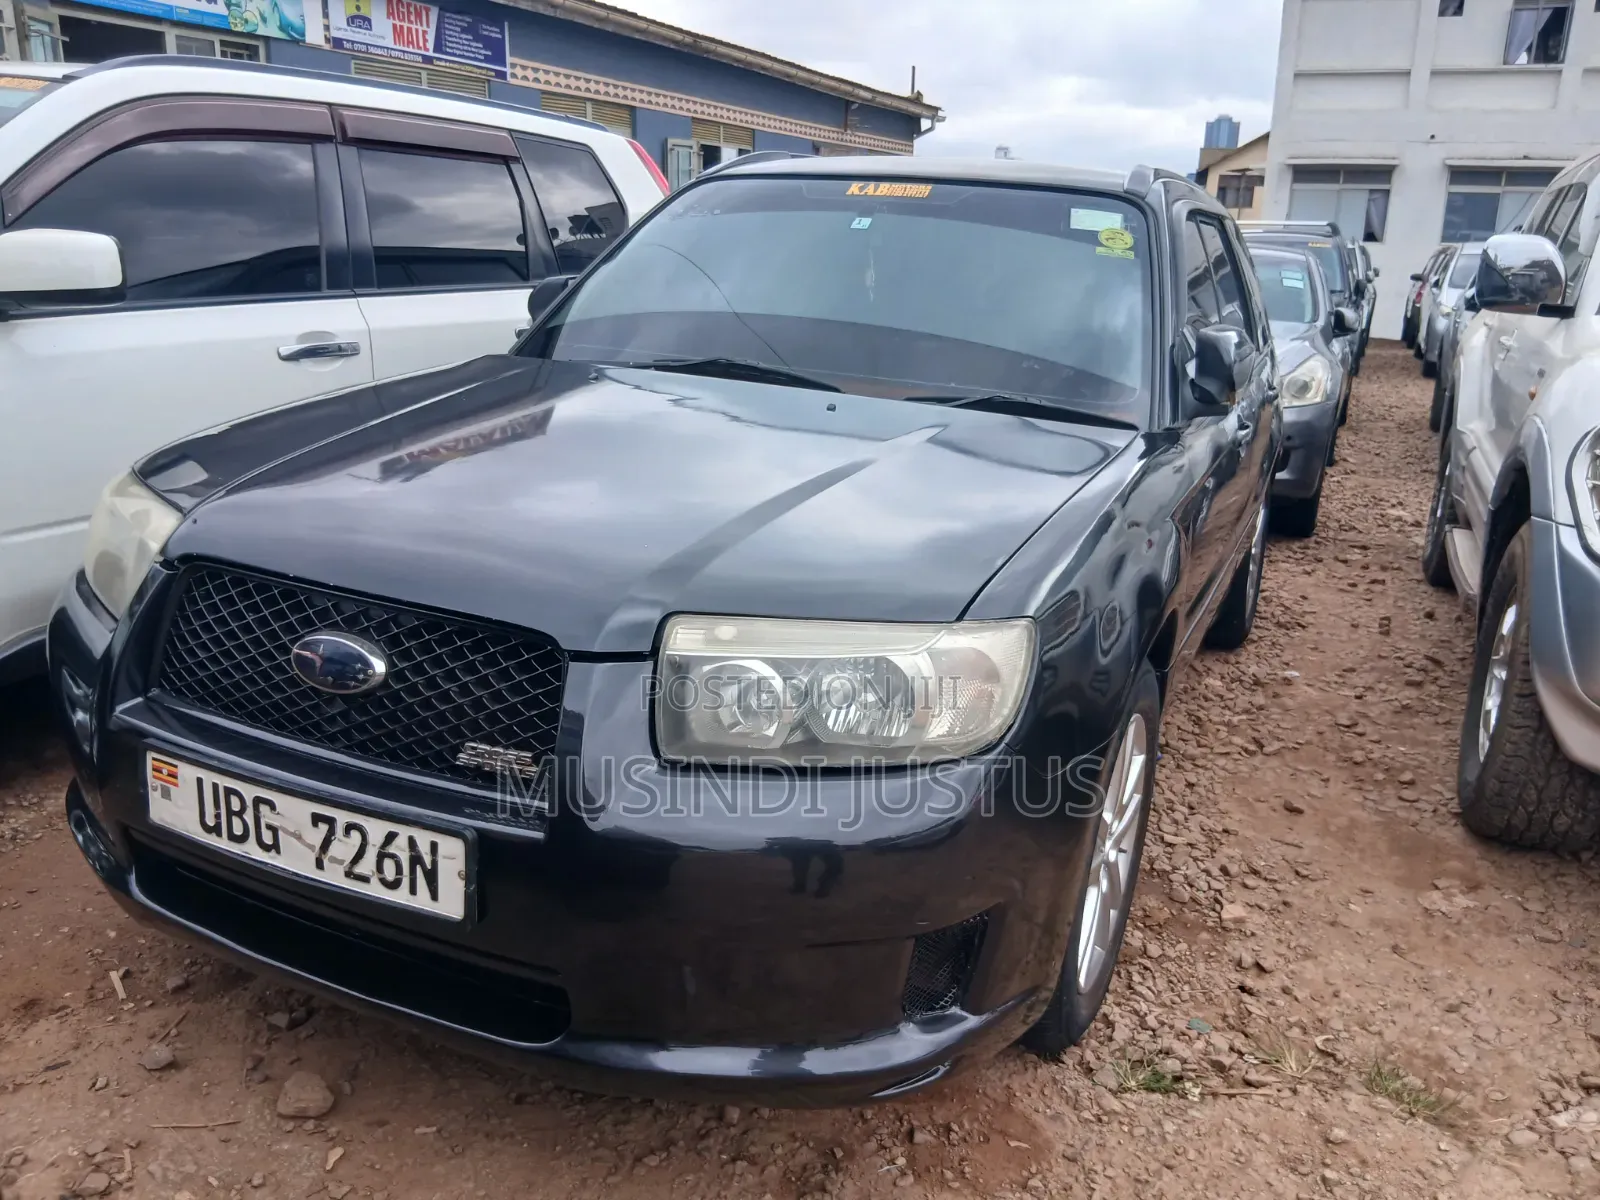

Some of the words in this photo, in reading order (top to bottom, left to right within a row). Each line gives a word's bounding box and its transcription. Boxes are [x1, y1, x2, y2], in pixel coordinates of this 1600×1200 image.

[348, 17, 371, 30] URA
[386, 0, 431, 28] AGENT
[392, 23, 430, 52] MALE
[845, 182, 890, 196] KAB
[463, 741, 533, 765] CROSS
[196, 776, 282, 856] UBG
[310, 811, 440, 902] 726N
